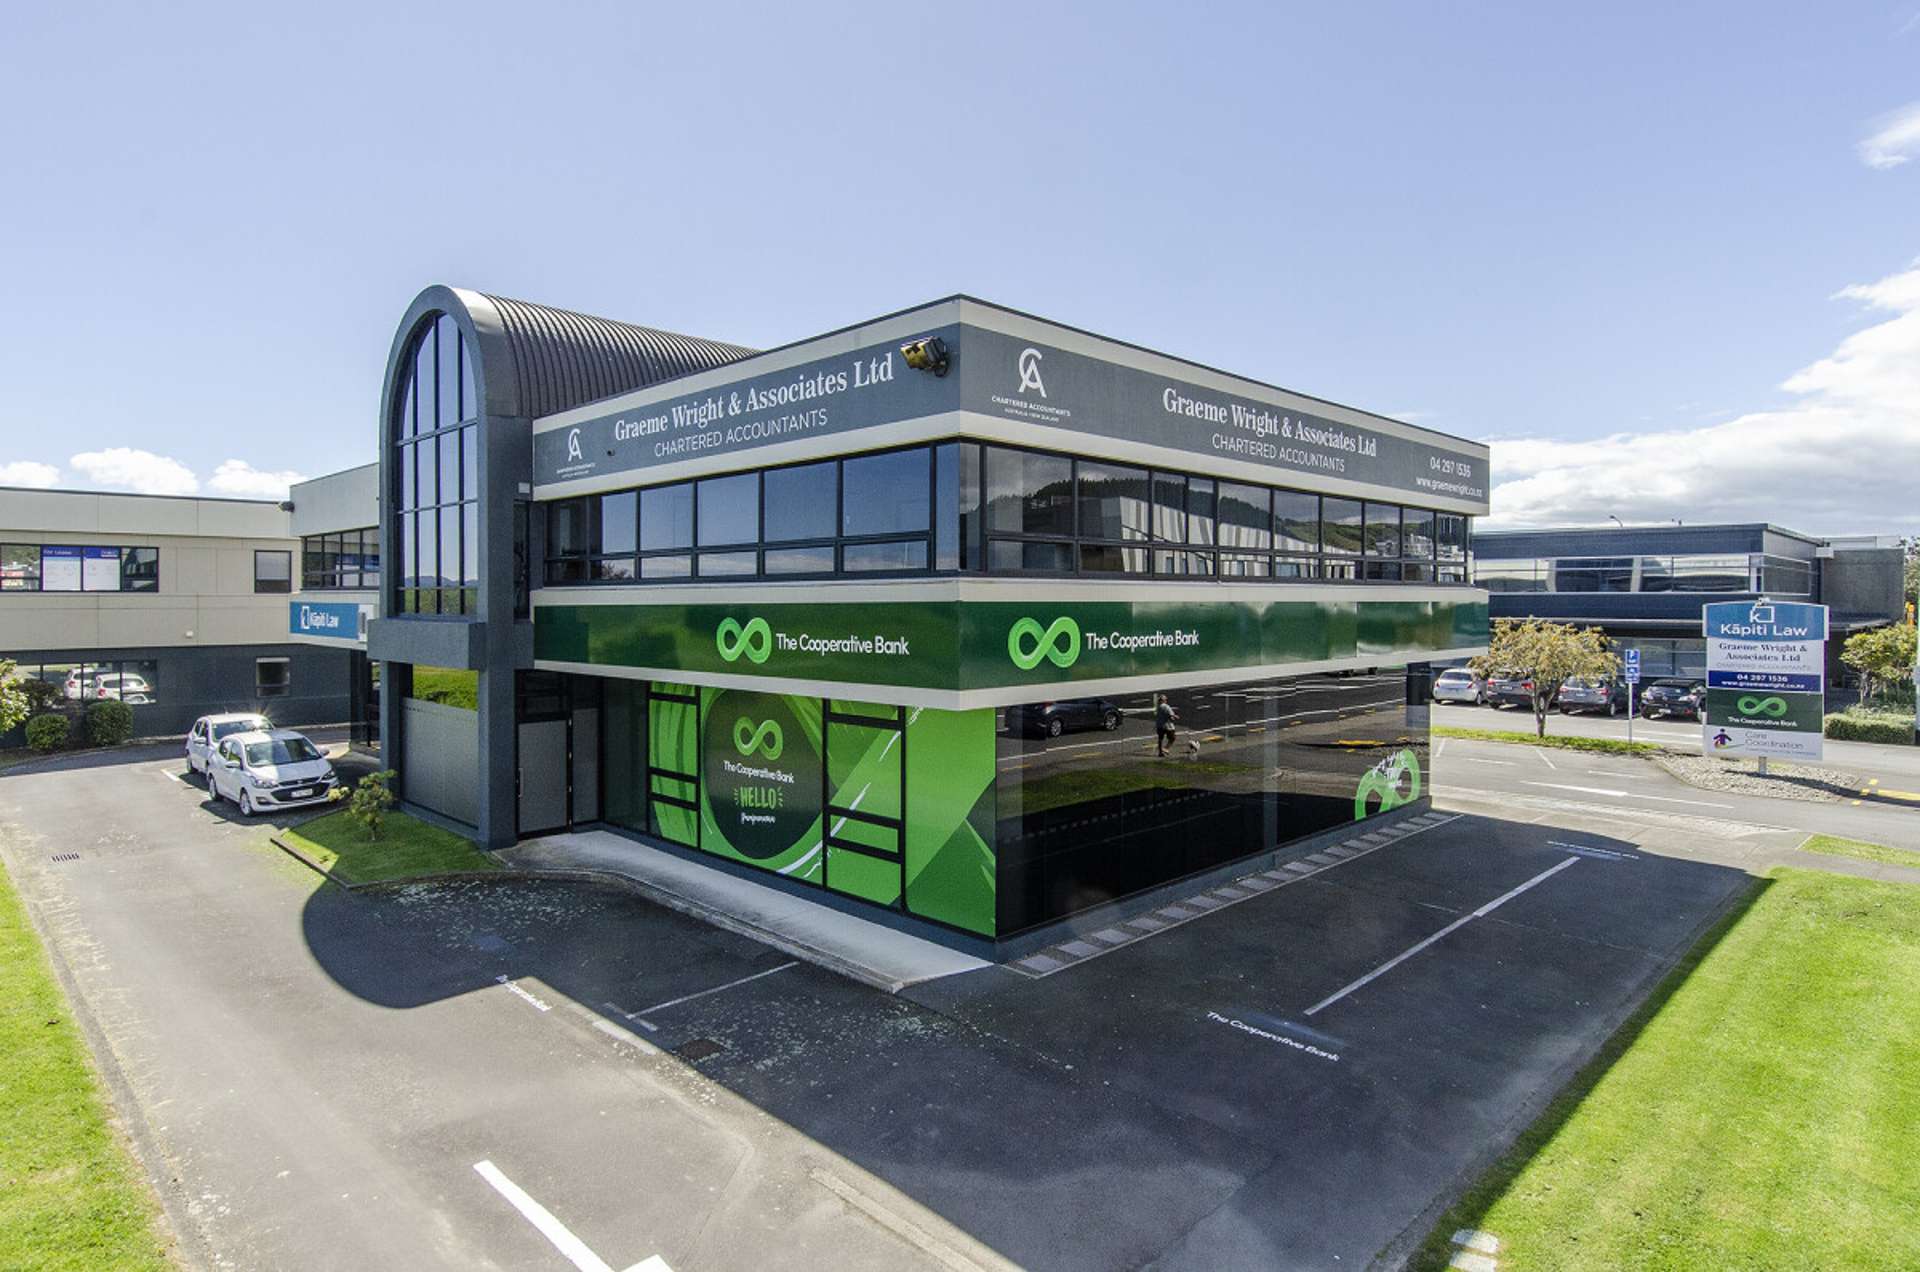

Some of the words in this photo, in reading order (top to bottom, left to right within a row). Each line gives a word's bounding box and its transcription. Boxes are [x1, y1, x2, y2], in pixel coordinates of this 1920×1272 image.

[615, 414, 668, 441] Graeme
[671, 396, 725, 429] Wright
[728, 391, 742, 417] &
[745, 371, 848, 412] Associates
[853, 351, 894, 389] Ltd
[654, 431, 722, 457] CHARTERED
[725, 408, 828, 444] ACCOUNTANTS
[1162, 387, 1228, 424] Graeme
[1230, 404, 1280, 438] Wright
[1281, 416, 1292, 438] &
[1294, 420, 1356, 452] Associates
[1358, 434, 1377, 457] Ltd
[1212, 433, 1277, 459] CHARTERED
[1279, 447, 1345, 473] ACCOUNTANTS
[1430, 456, 1441, 471] 04
[1085, 632, 1109, 650] The
[1110, 630, 1174, 653] Cooperative
[1175, 629, 1200, 646] Bank
[1720, 623, 1768, 637] Kāpiti
[1773, 624, 1808, 637] Law
[775, 633, 798, 650] The
[799, 633, 873, 657] Cooperative
[875, 635, 910, 656] Bank
[1719, 642, 1759, 652] Graeme
[1760, 643, 1797, 654] Wright
[1799, 644, 1808, 653] &
[1725, 652, 1779, 661] Associates
[1781, 653, 1801, 662] Ltd
[1737, 673, 1748, 681] 04
[723, 760, 736, 772] The
[735, 762, 776, 779] Cooperative
[775, 770, 795, 784] Bank
[740, 786, 777, 810] HELLO
[1207, 1010, 1230, 1024] The
